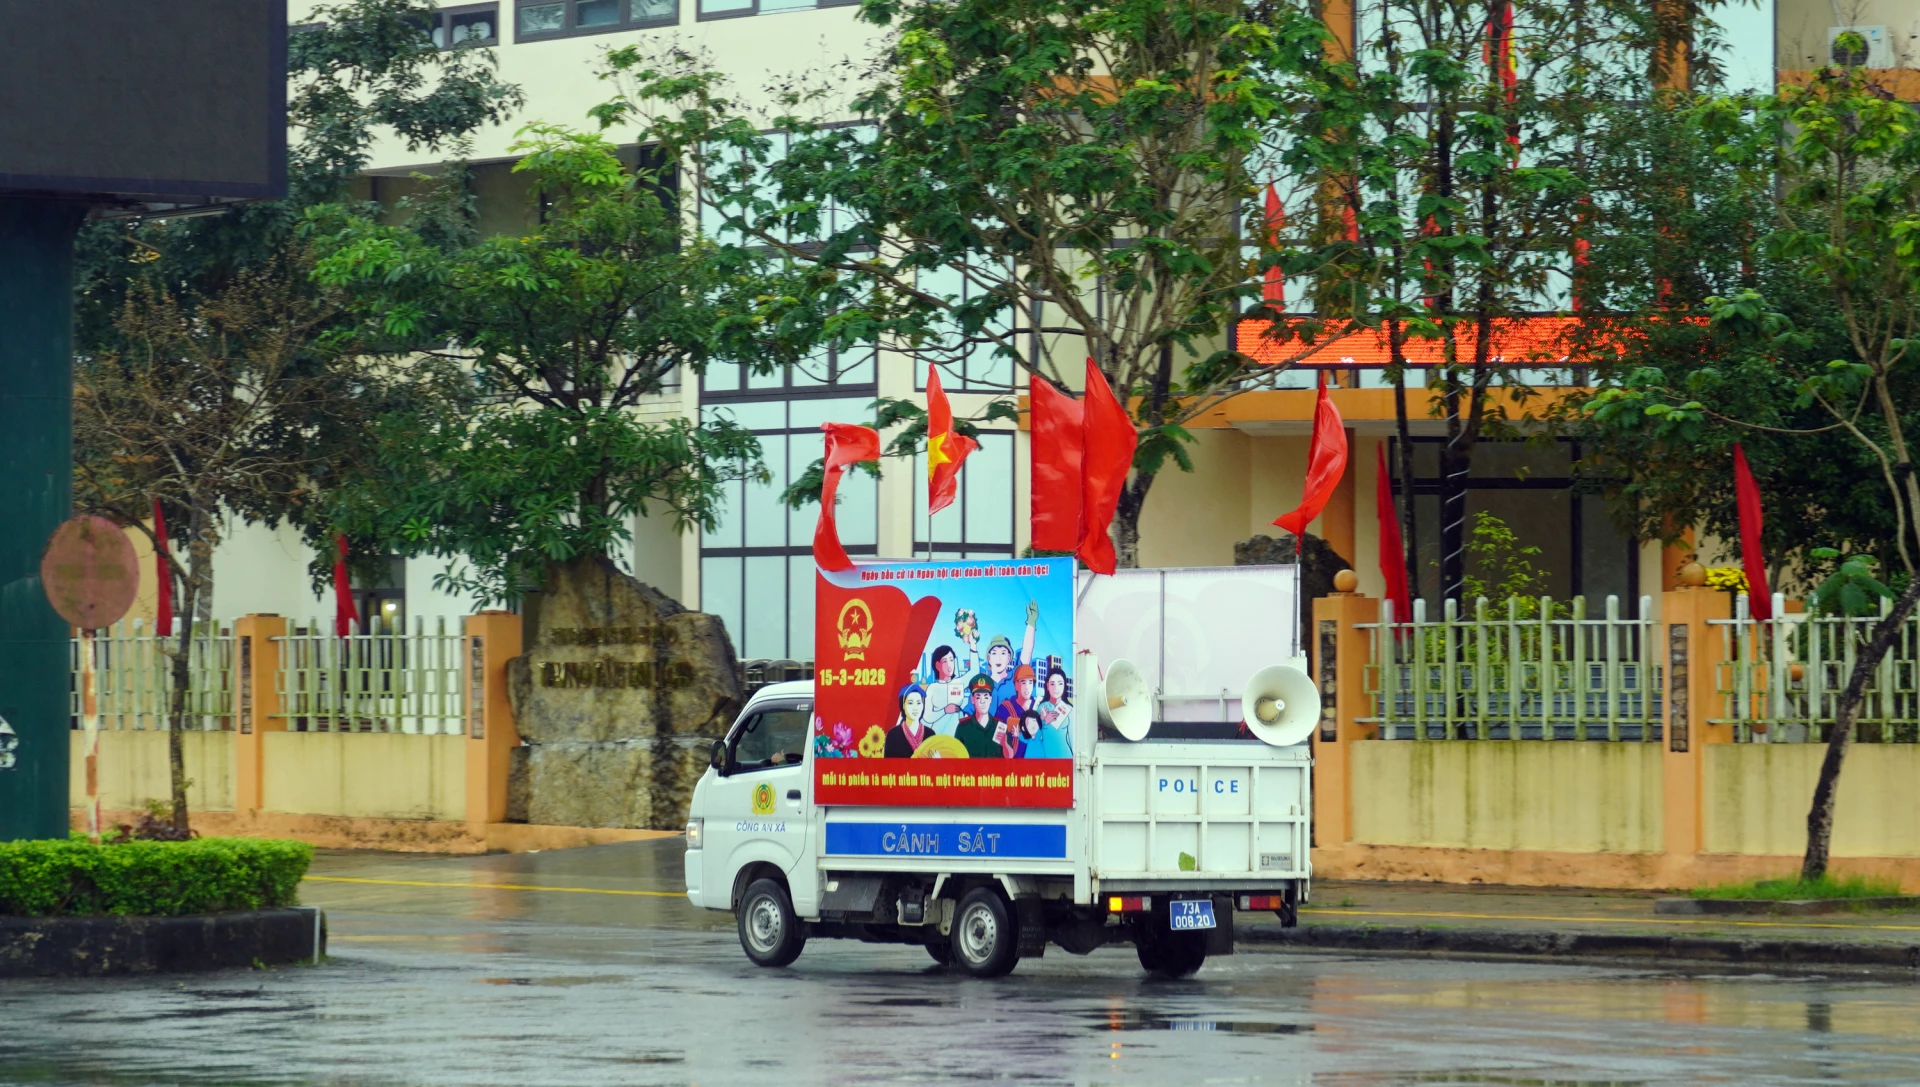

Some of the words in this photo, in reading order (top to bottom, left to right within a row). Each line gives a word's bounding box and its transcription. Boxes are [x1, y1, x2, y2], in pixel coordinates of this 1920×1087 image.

[861, 570, 879, 581] Ngày
[880, 568, 894, 580] bầu
[916, 569, 934, 580] Ngày
[820, 668, 886, 686] 15-3-2026
[953, 774, 976, 787] trách
[978, 773, 1003, 789] nhiệm
[1159, 779, 1239, 794] POLCE
[736, 820, 759, 832] CÔNG
[761, 823, 772, 832] AN
[774, 821, 786, 832] XÃ
[882, 824, 939, 854] CẢNH
[958, 826, 1001, 853] SÁT
[1182, 902, 1200, 915] 73A
